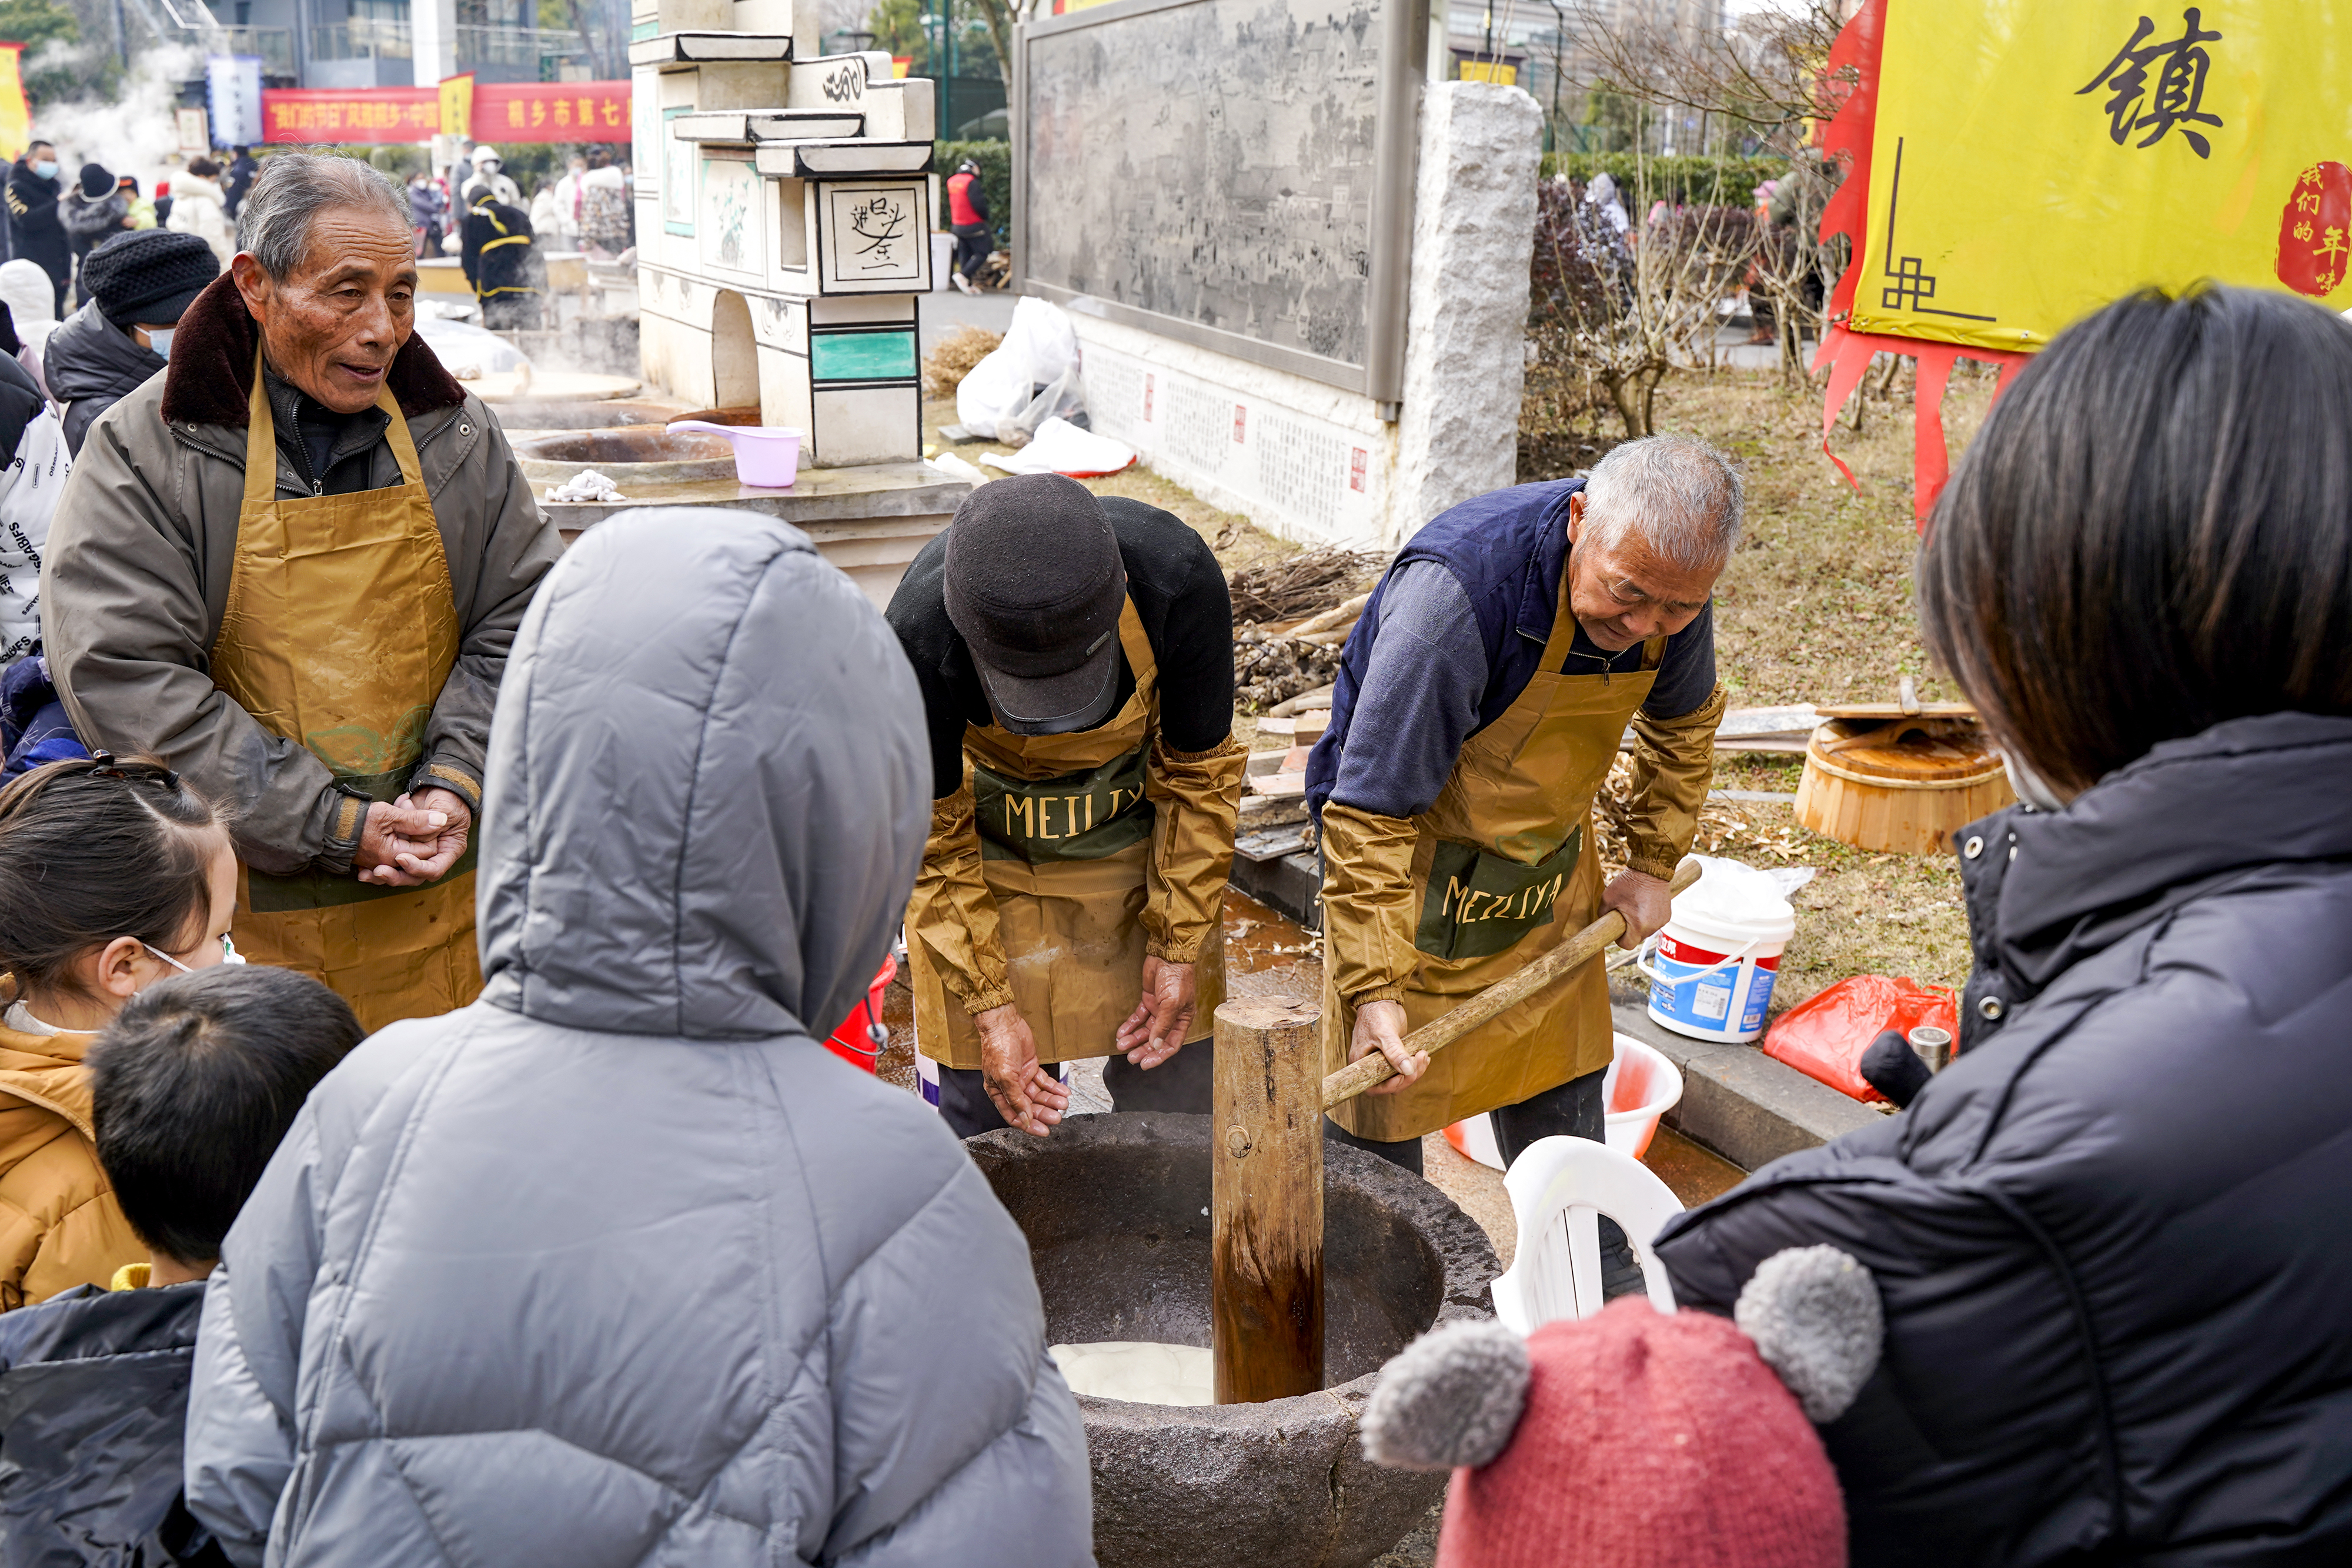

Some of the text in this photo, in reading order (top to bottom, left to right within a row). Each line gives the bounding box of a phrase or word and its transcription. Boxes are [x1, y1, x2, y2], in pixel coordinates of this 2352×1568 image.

[2294, 164, 2323, 243] 我们的
[2313, 225, 2348, 293] 年味
